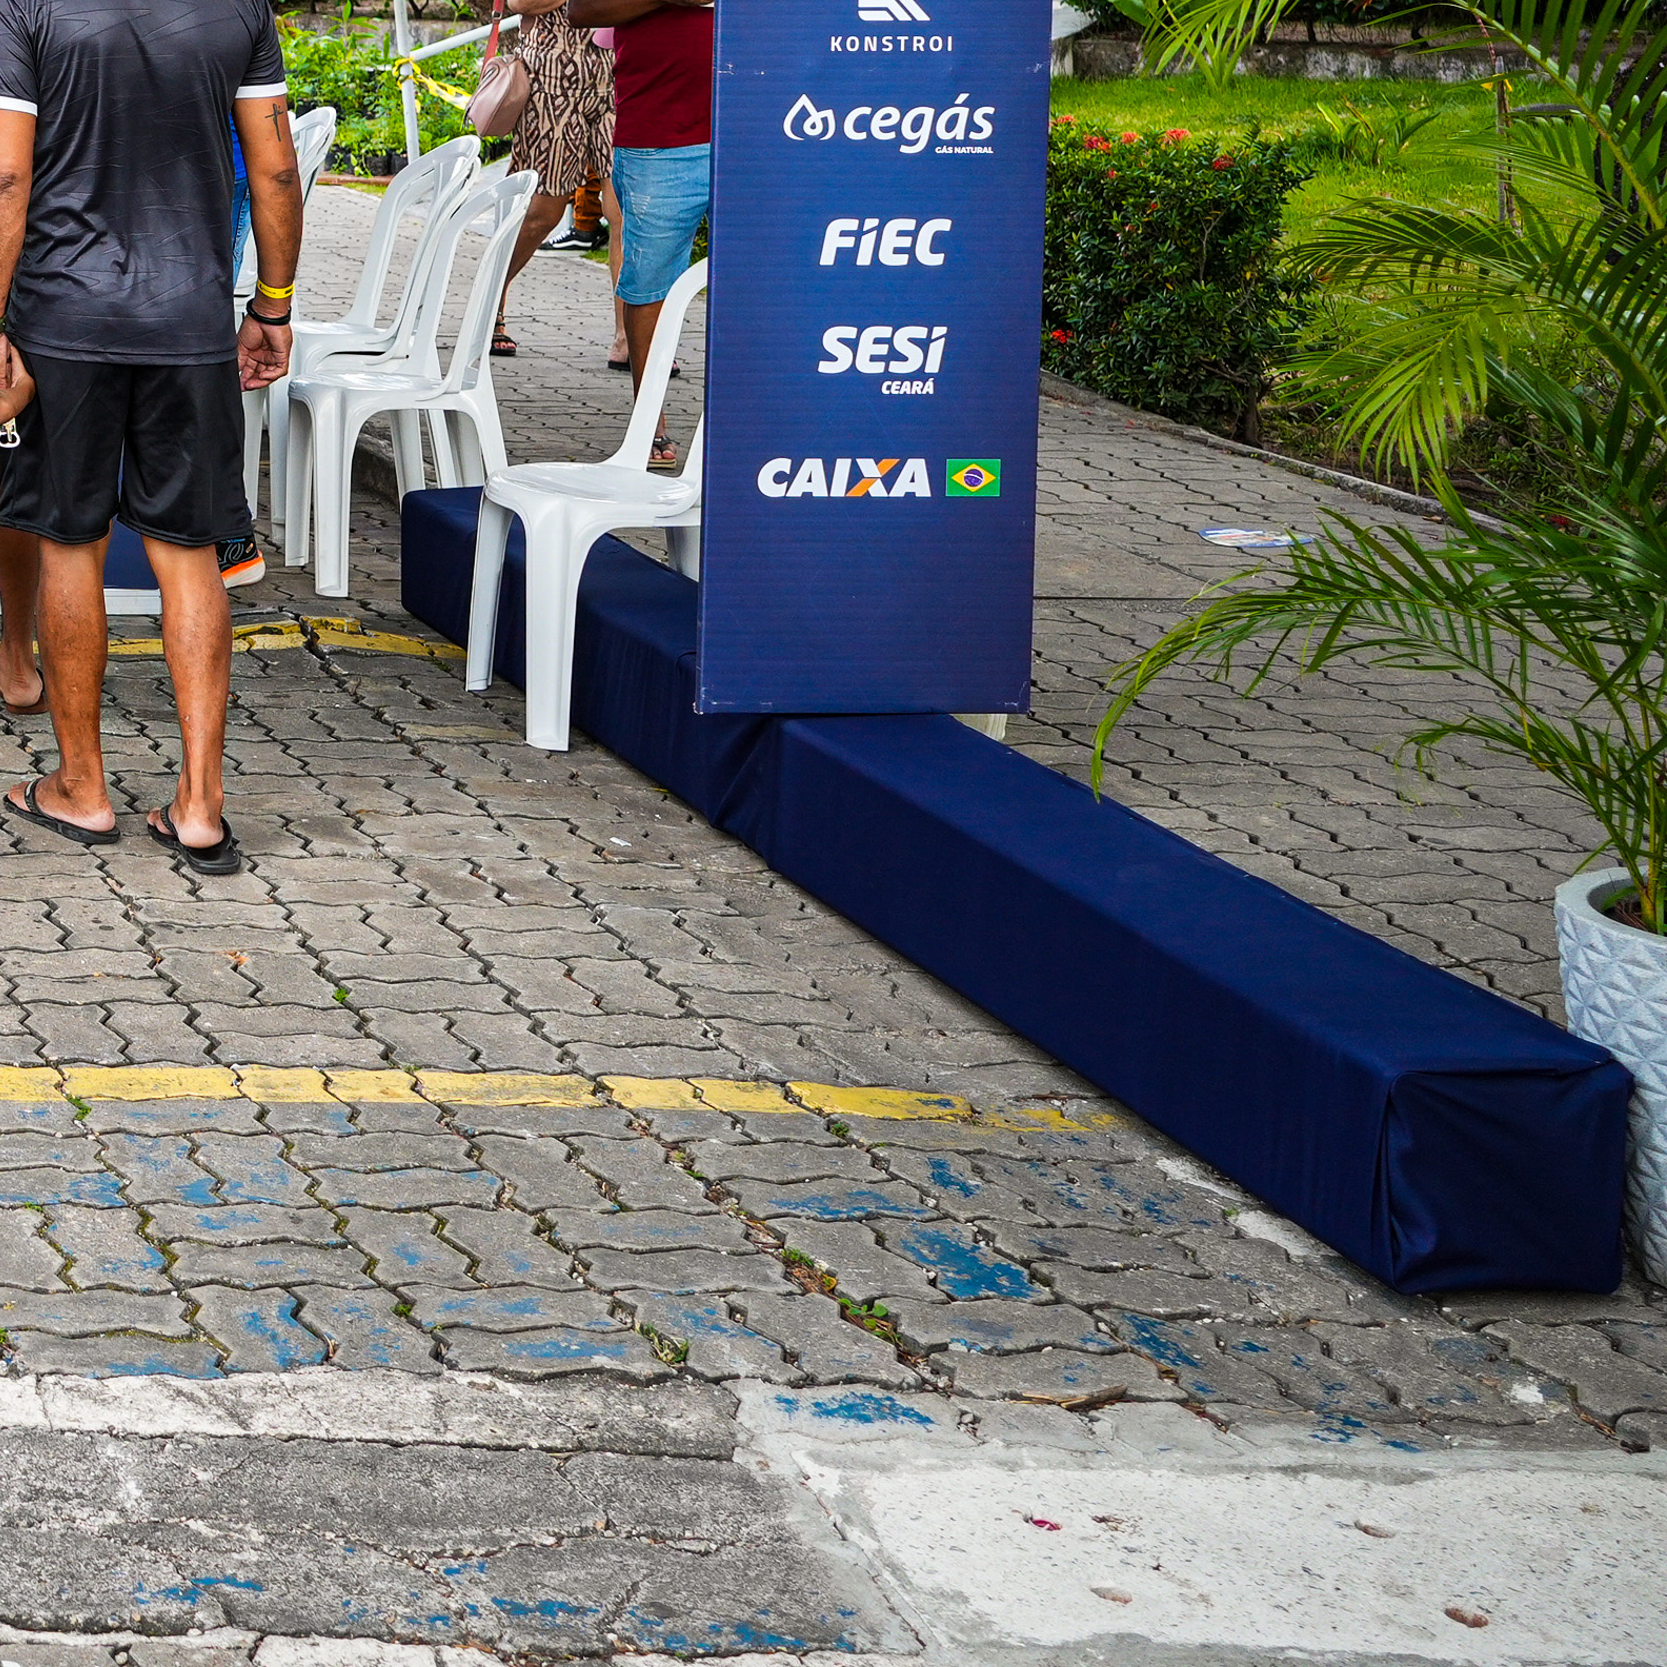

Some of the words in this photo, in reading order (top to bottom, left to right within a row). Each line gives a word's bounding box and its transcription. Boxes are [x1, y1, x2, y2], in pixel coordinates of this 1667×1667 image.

[830, 36, 953, 52] KONSTROI
[843, 93, 996, 154] cegás
[935, 145, 953, 154] GÁS
[954, 146, 994, 154] NATURAL
[881, 376, 935, 395] CEARÁ
[757, 456, 932, 498] CAIXA
